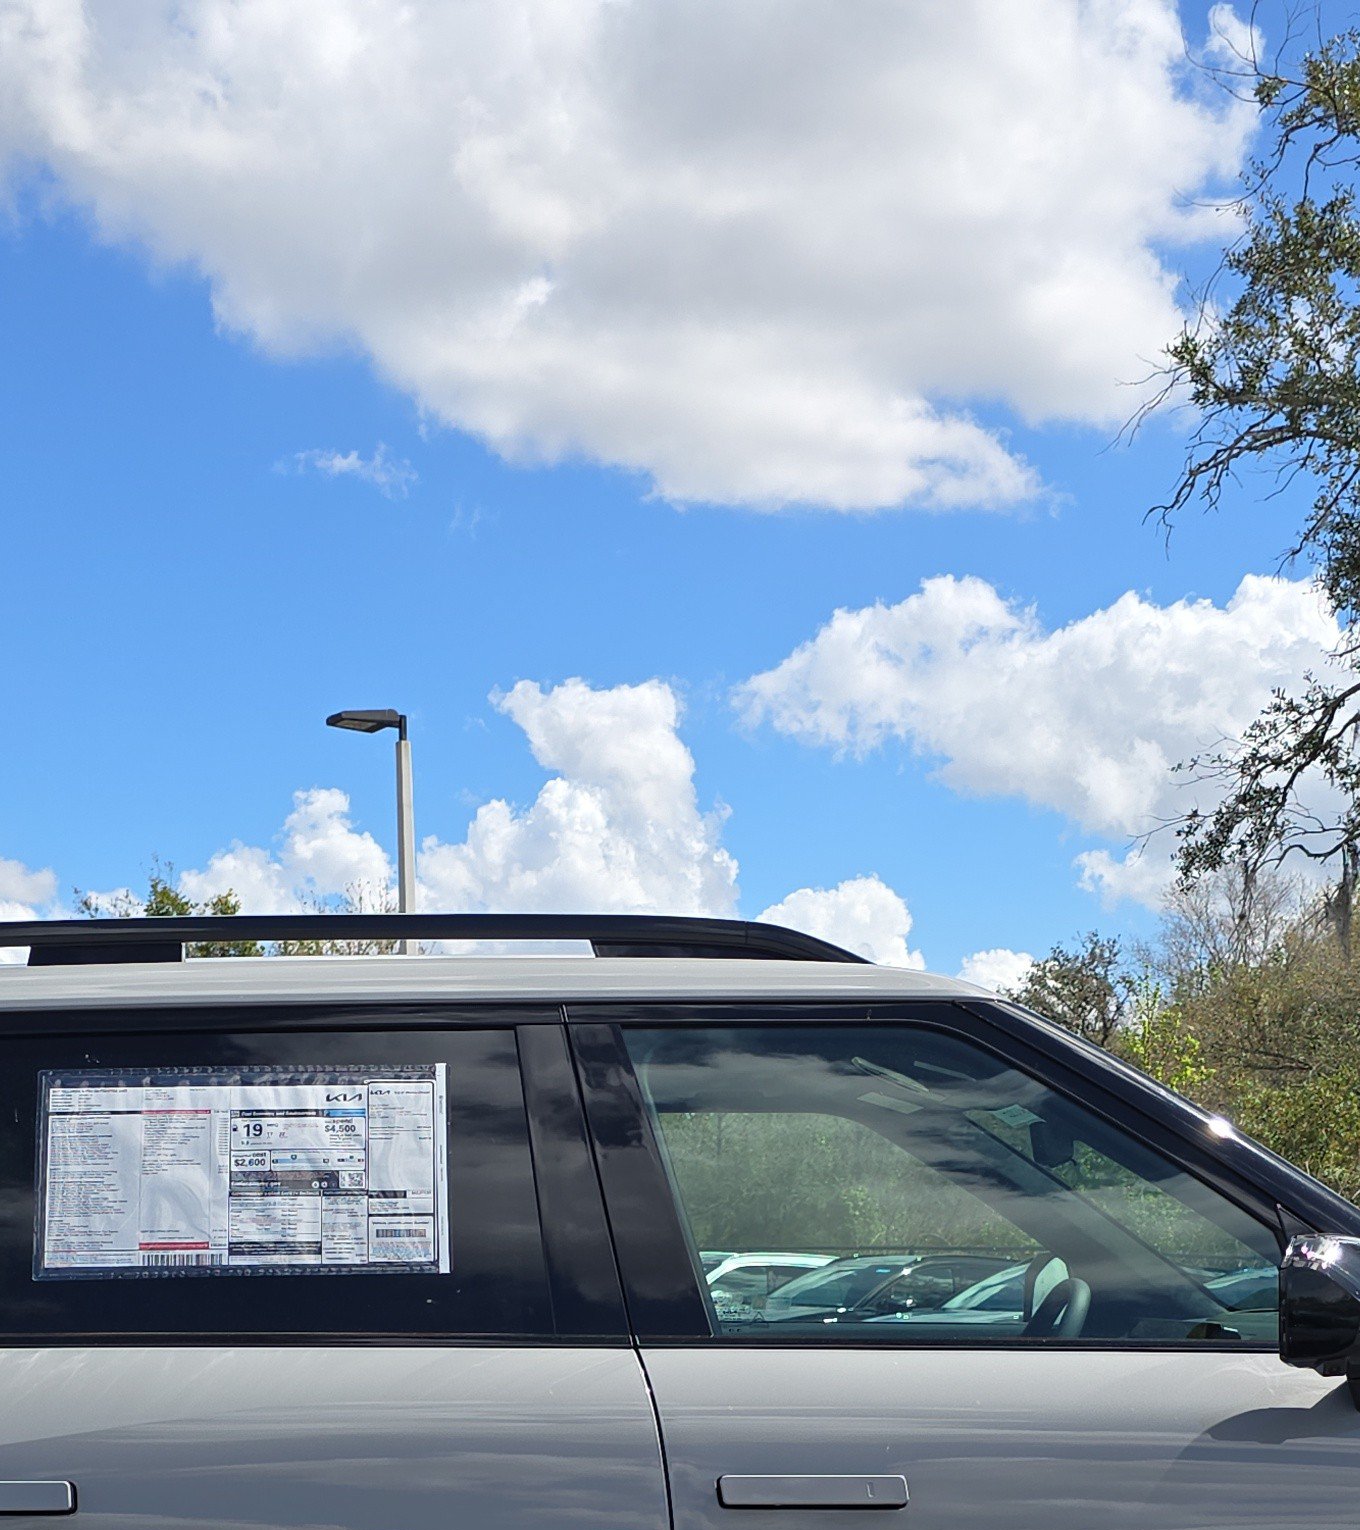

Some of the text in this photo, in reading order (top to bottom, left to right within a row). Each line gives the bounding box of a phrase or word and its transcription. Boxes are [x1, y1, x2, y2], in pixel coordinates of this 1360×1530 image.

[325, 1093, 362, 1102] KIA
[243, 1123, 263, 1137] 19
[324, 1124, 356, 1133] $4,500
[234, 1158, 266, 1167] $2,600
